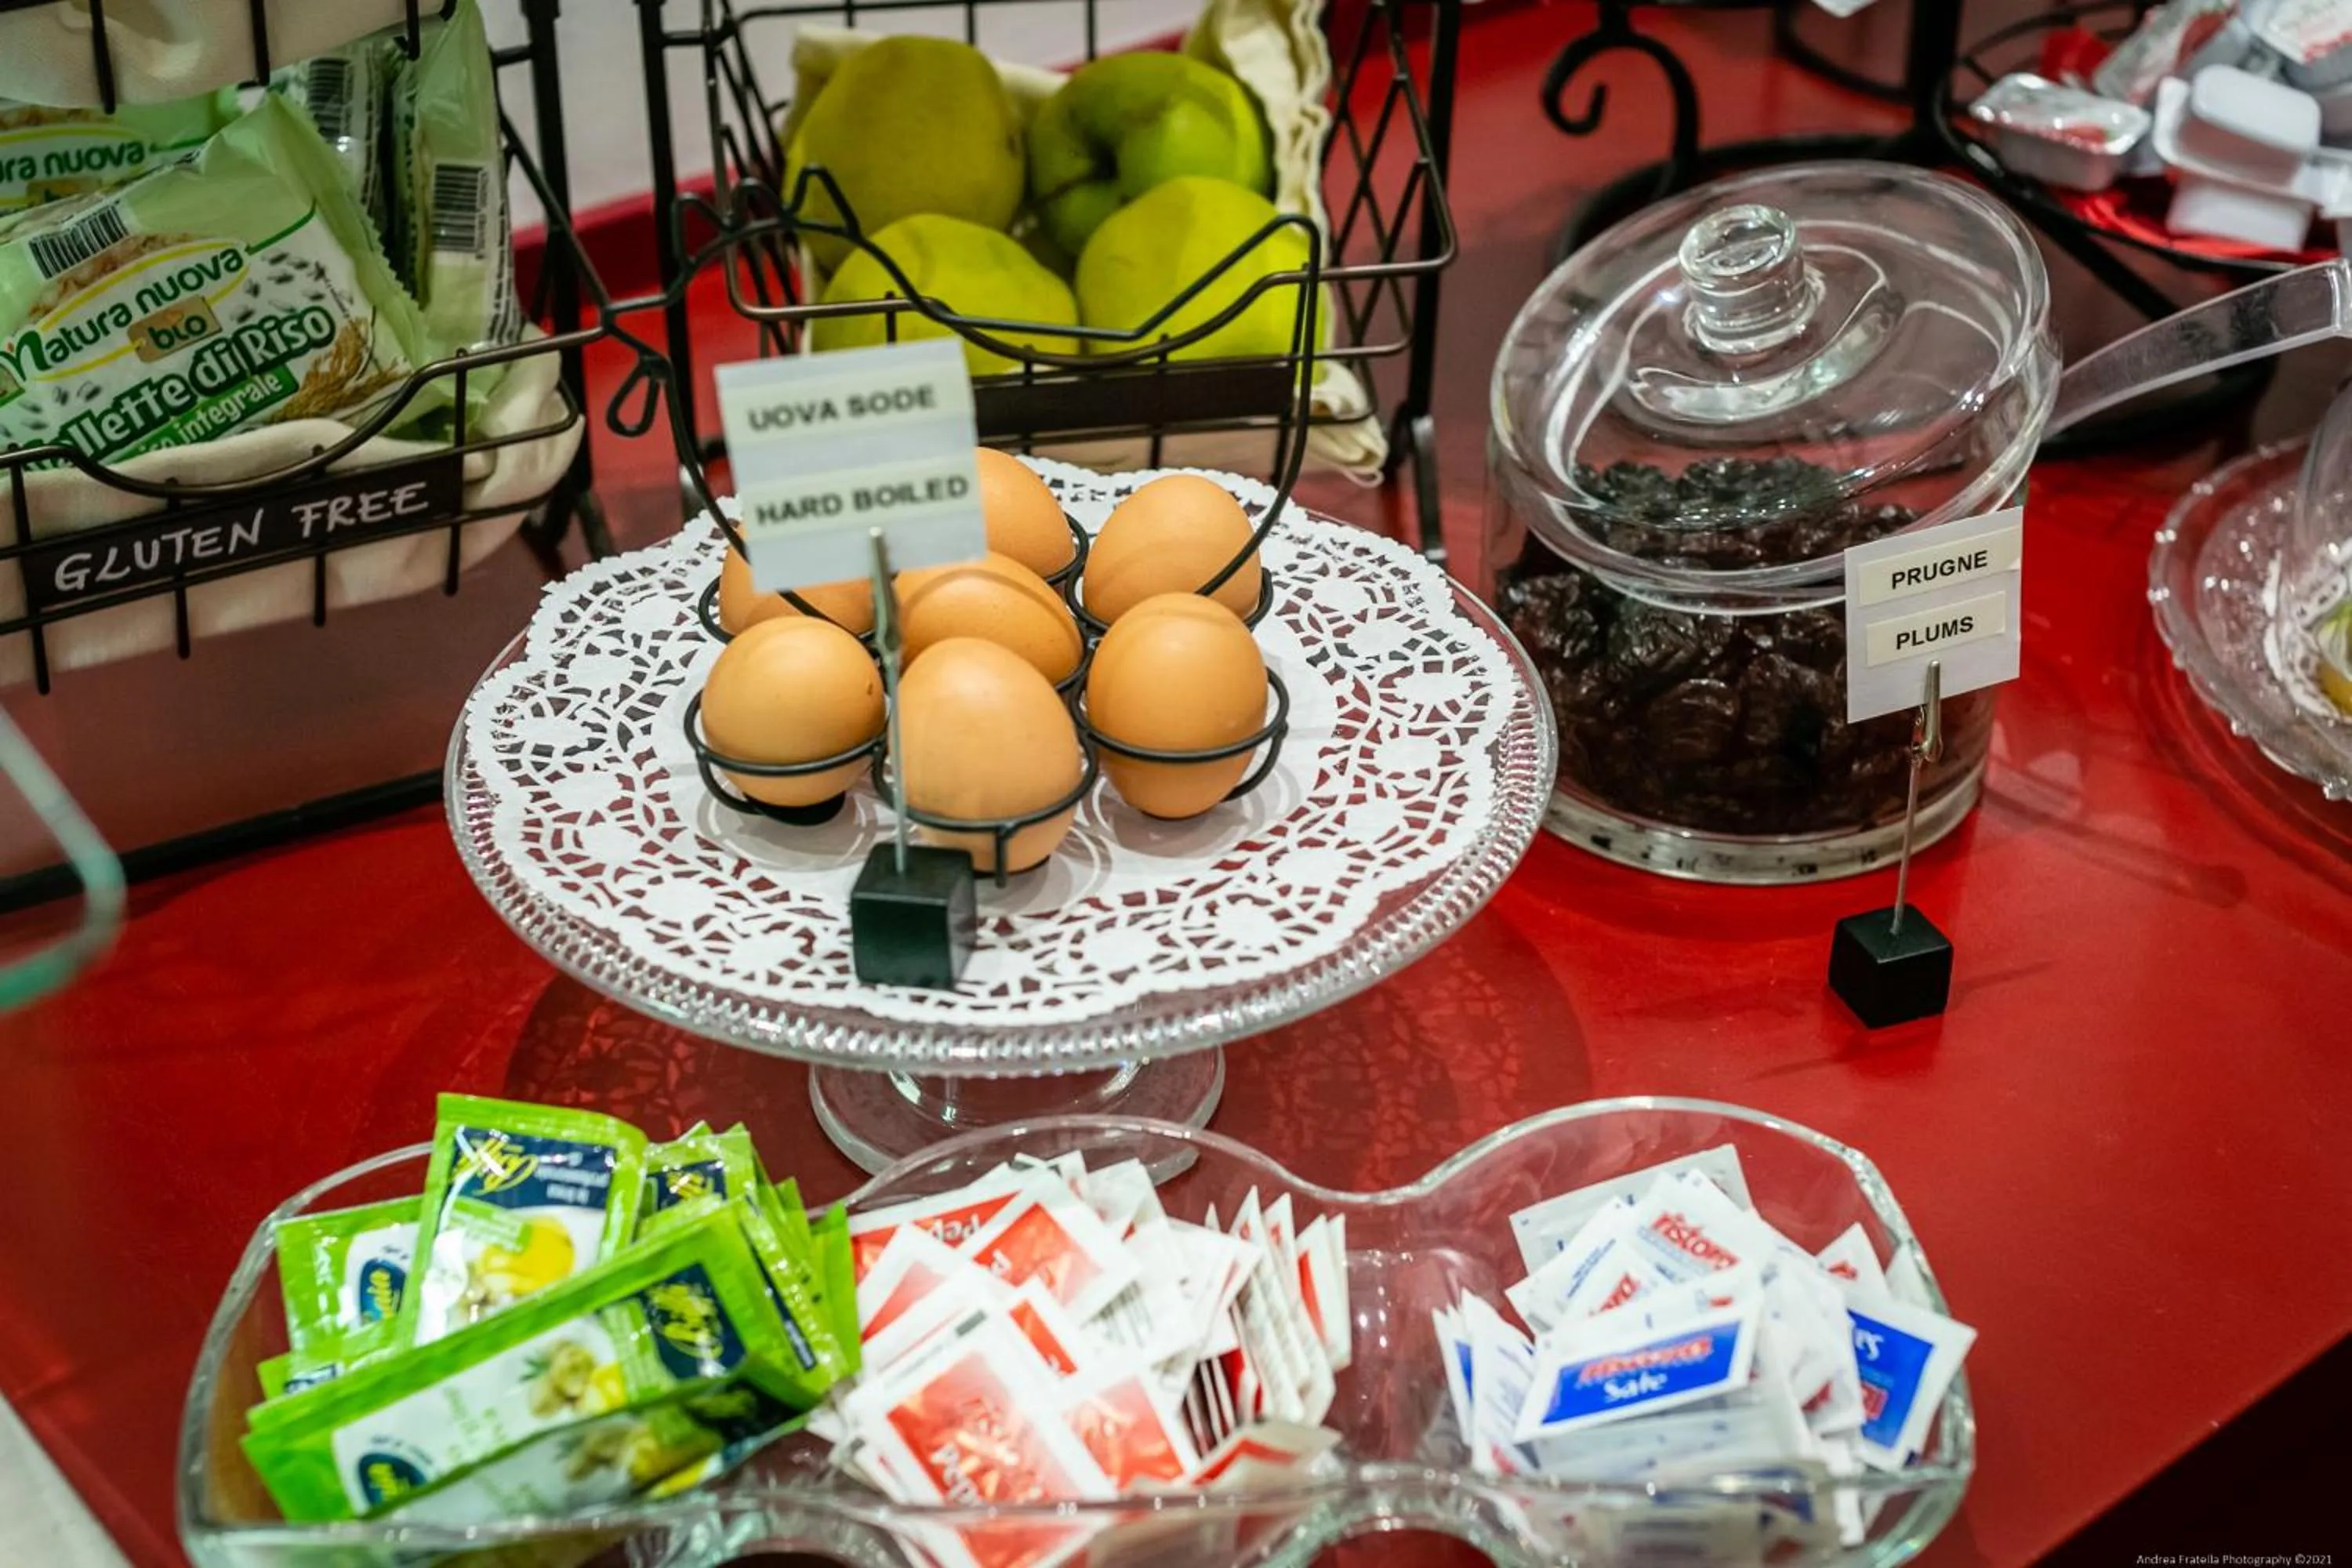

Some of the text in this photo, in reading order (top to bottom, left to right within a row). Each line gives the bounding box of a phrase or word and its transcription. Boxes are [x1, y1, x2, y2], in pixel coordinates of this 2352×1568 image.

[44, 140, 146, 176] nuova
[136, 248, 244, 314] nuova
[148, 314, 207, 350] bio
[194, 342, 240, 387] di
[249, 309, 333, 365] Riso
[177, 374, 283, 445] integrale
[748, 384, 937, 433] UOVA SODE
[755, 474, 970, 527] HARD BOILED
[54, 482, 429, 592] GLUTEN FREE
[1891, 550, 1988, 590] PRUGNE
[1896, 615, 1974, 650] PLUMS
